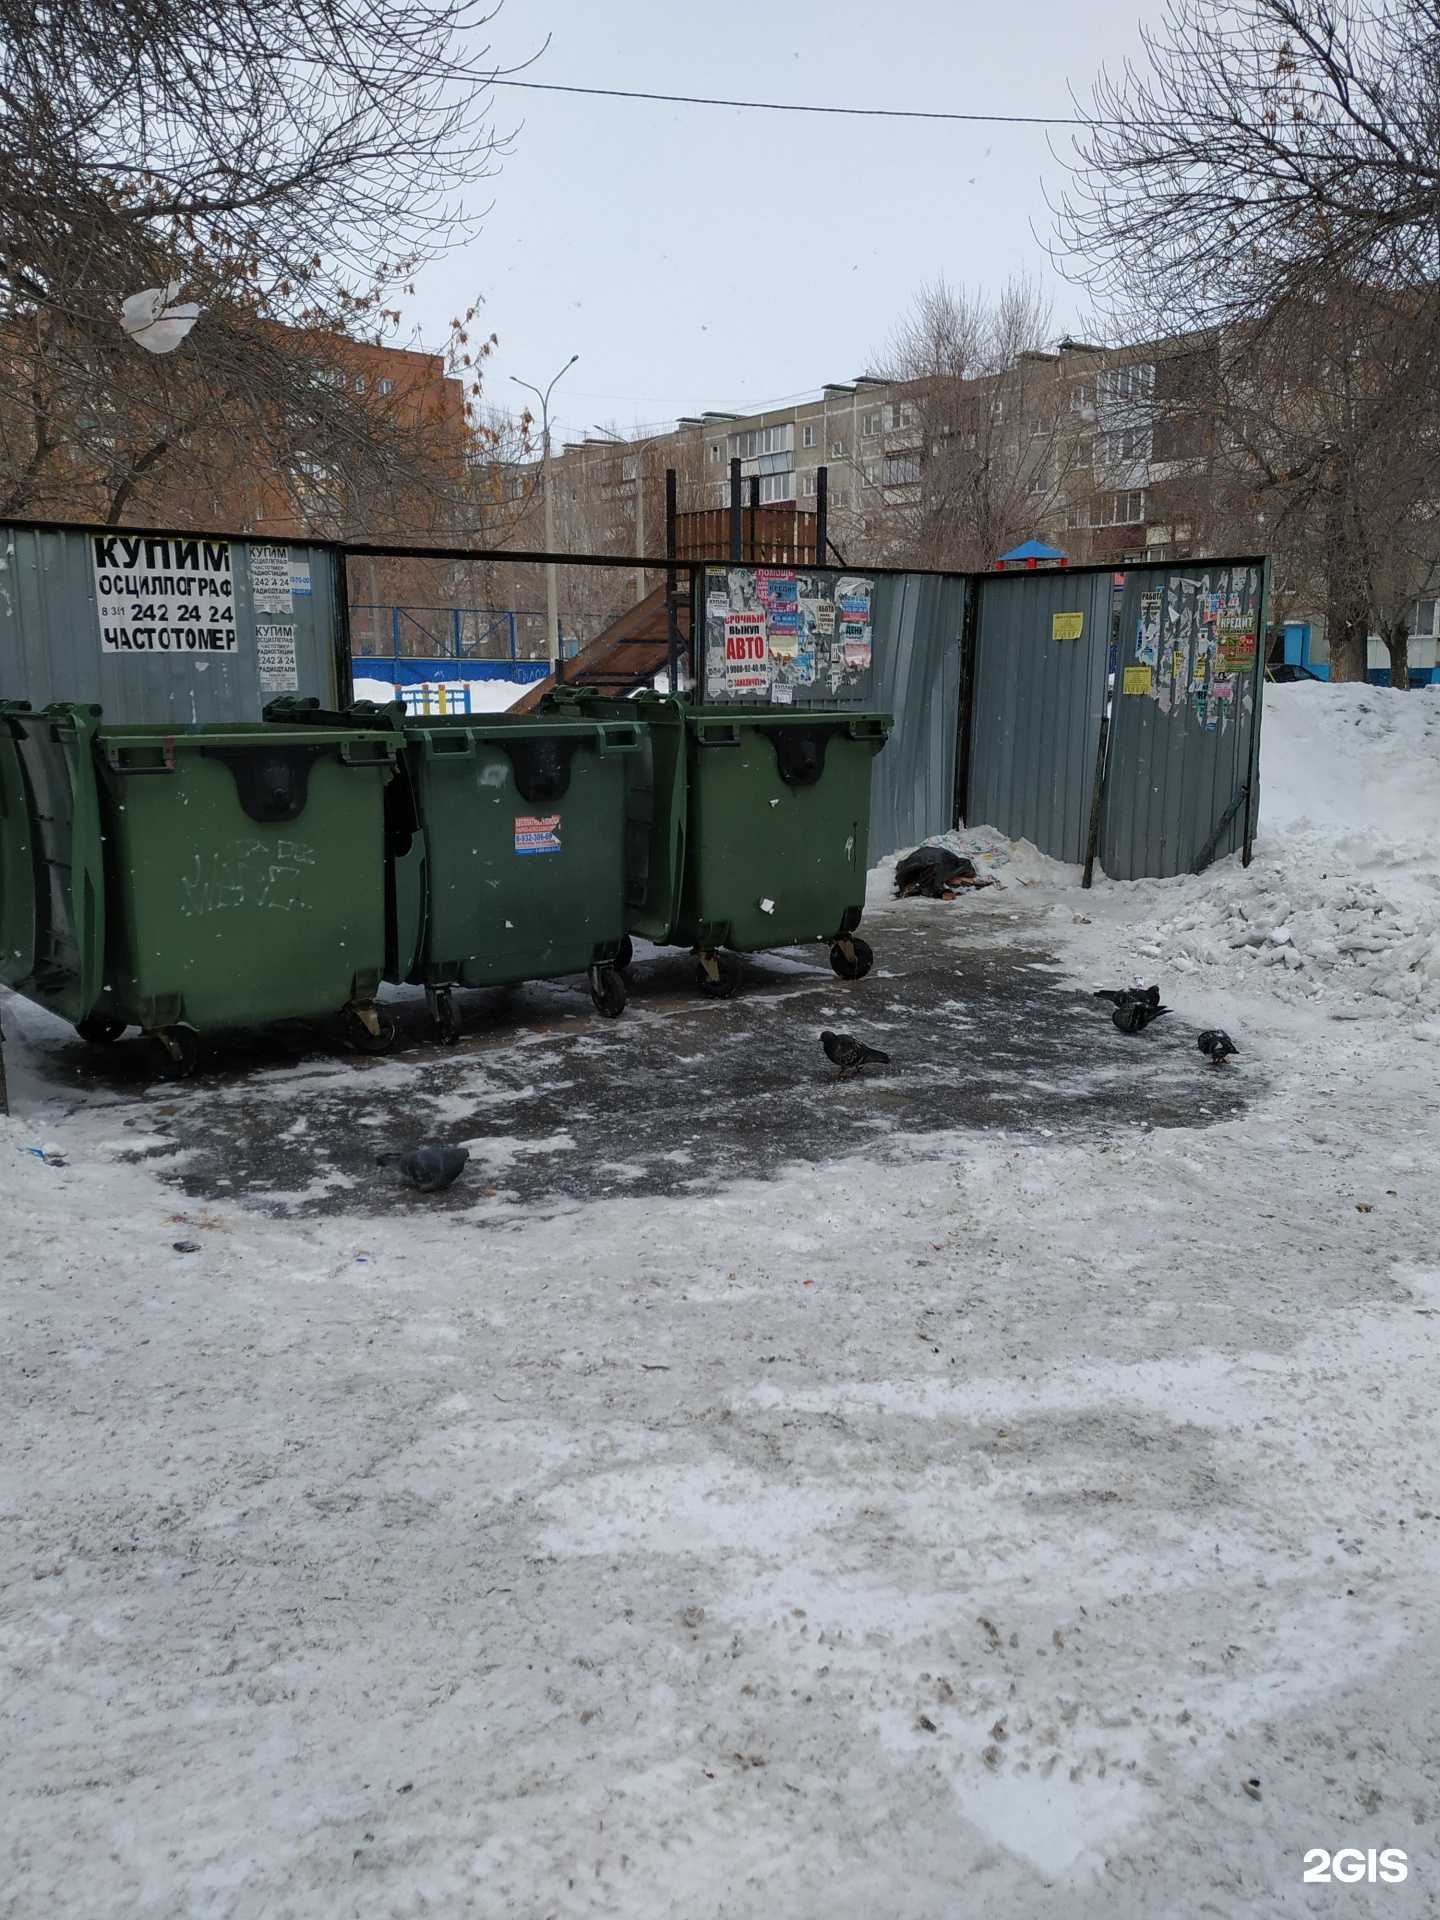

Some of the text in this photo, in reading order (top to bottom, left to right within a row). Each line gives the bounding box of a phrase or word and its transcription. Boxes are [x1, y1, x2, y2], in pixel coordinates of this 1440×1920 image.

[95, 537, 230, 572] КУПИМ
[249, 546, 287, 558] КУПИМ
[131, 604, 168, 621] 242
[177, 605, 202, 622] 24
[208, 606, 233, 623] 24
[104, 627, 236, 650] ЧАСТОТОМЕР
[255, 626, 293, 637] КУПИМ
[729, 625, 759, 635] ВЫКУП
[727, 636, 764, 660] АВТО
